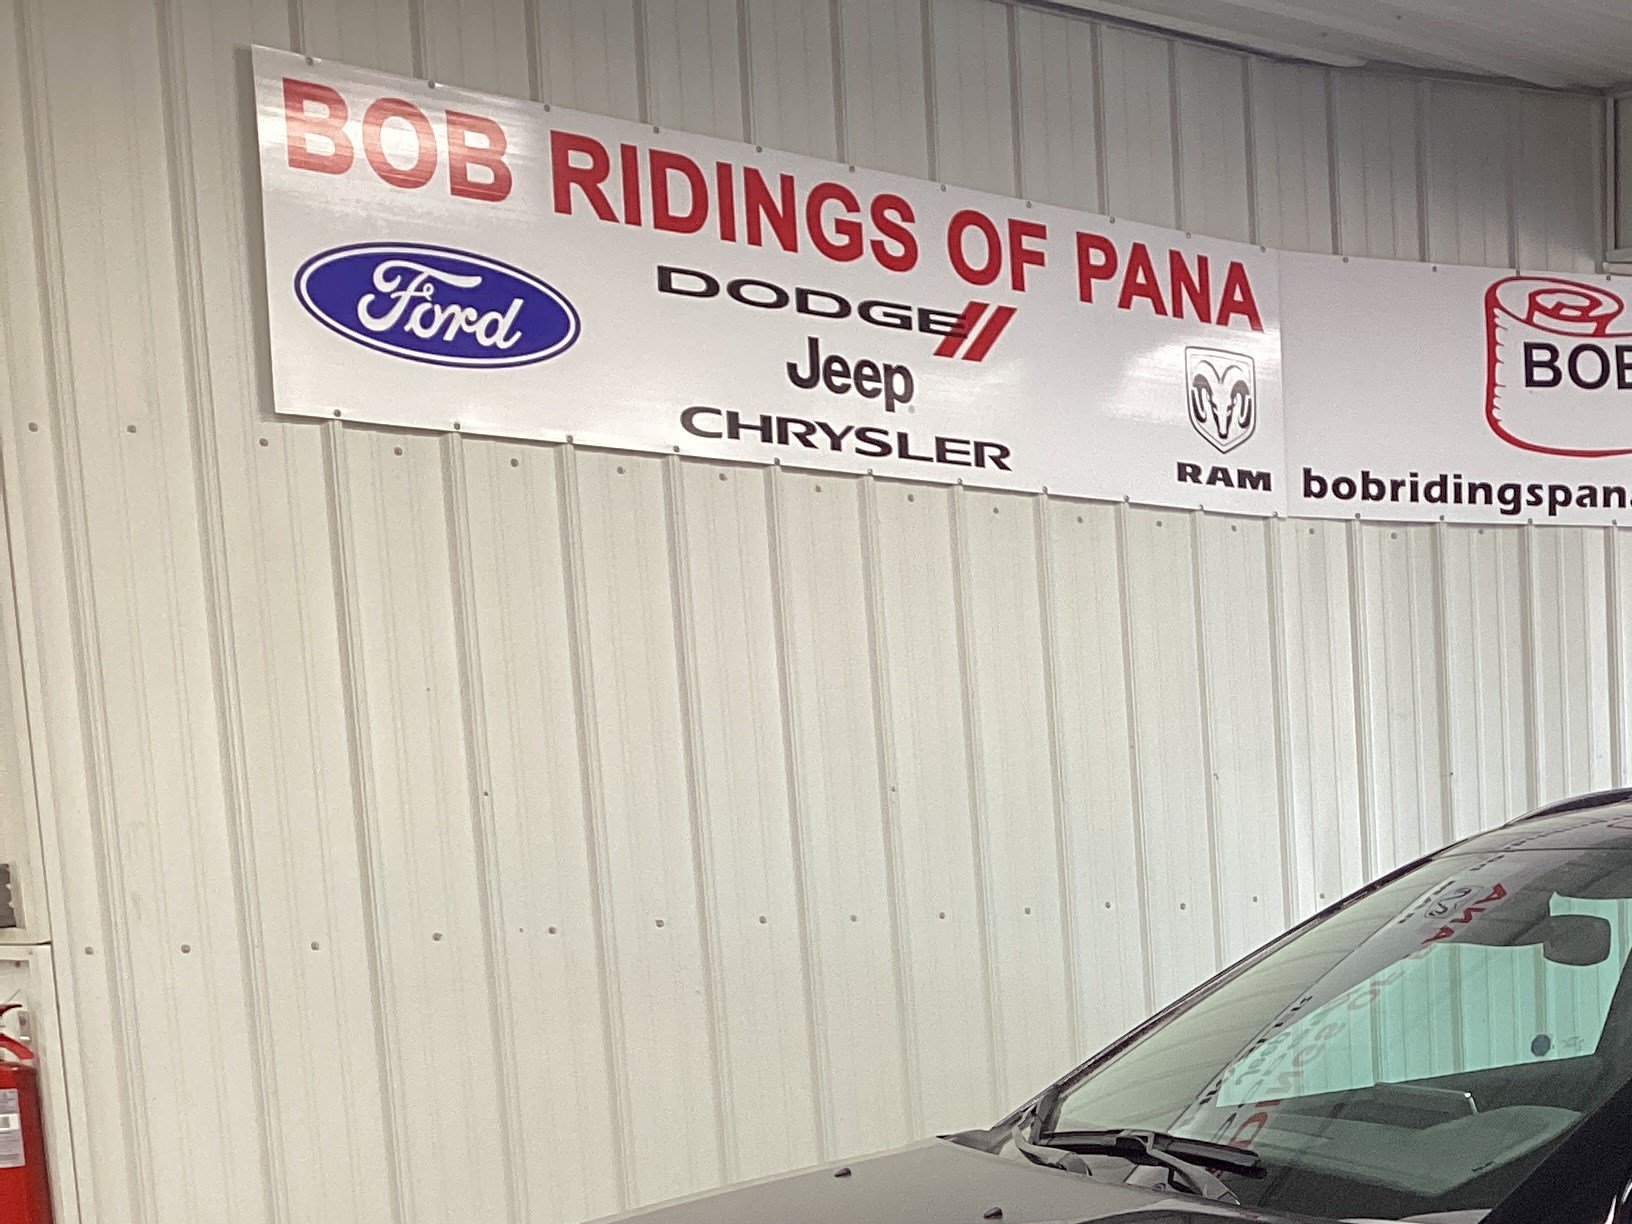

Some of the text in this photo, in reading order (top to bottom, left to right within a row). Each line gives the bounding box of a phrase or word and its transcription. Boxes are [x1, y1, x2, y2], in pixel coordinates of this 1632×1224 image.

[282, 77, 1265, 333] BOB RIDINGS OF PANA
[356, 260, 522, 350] Ford
[657, 264, 968, 338] DODGE
[787, 336, 914, 413] Jeep
[680, 406, 1012, 471] CHRYSLER
[1177, 462, 1272, 492] RAM
